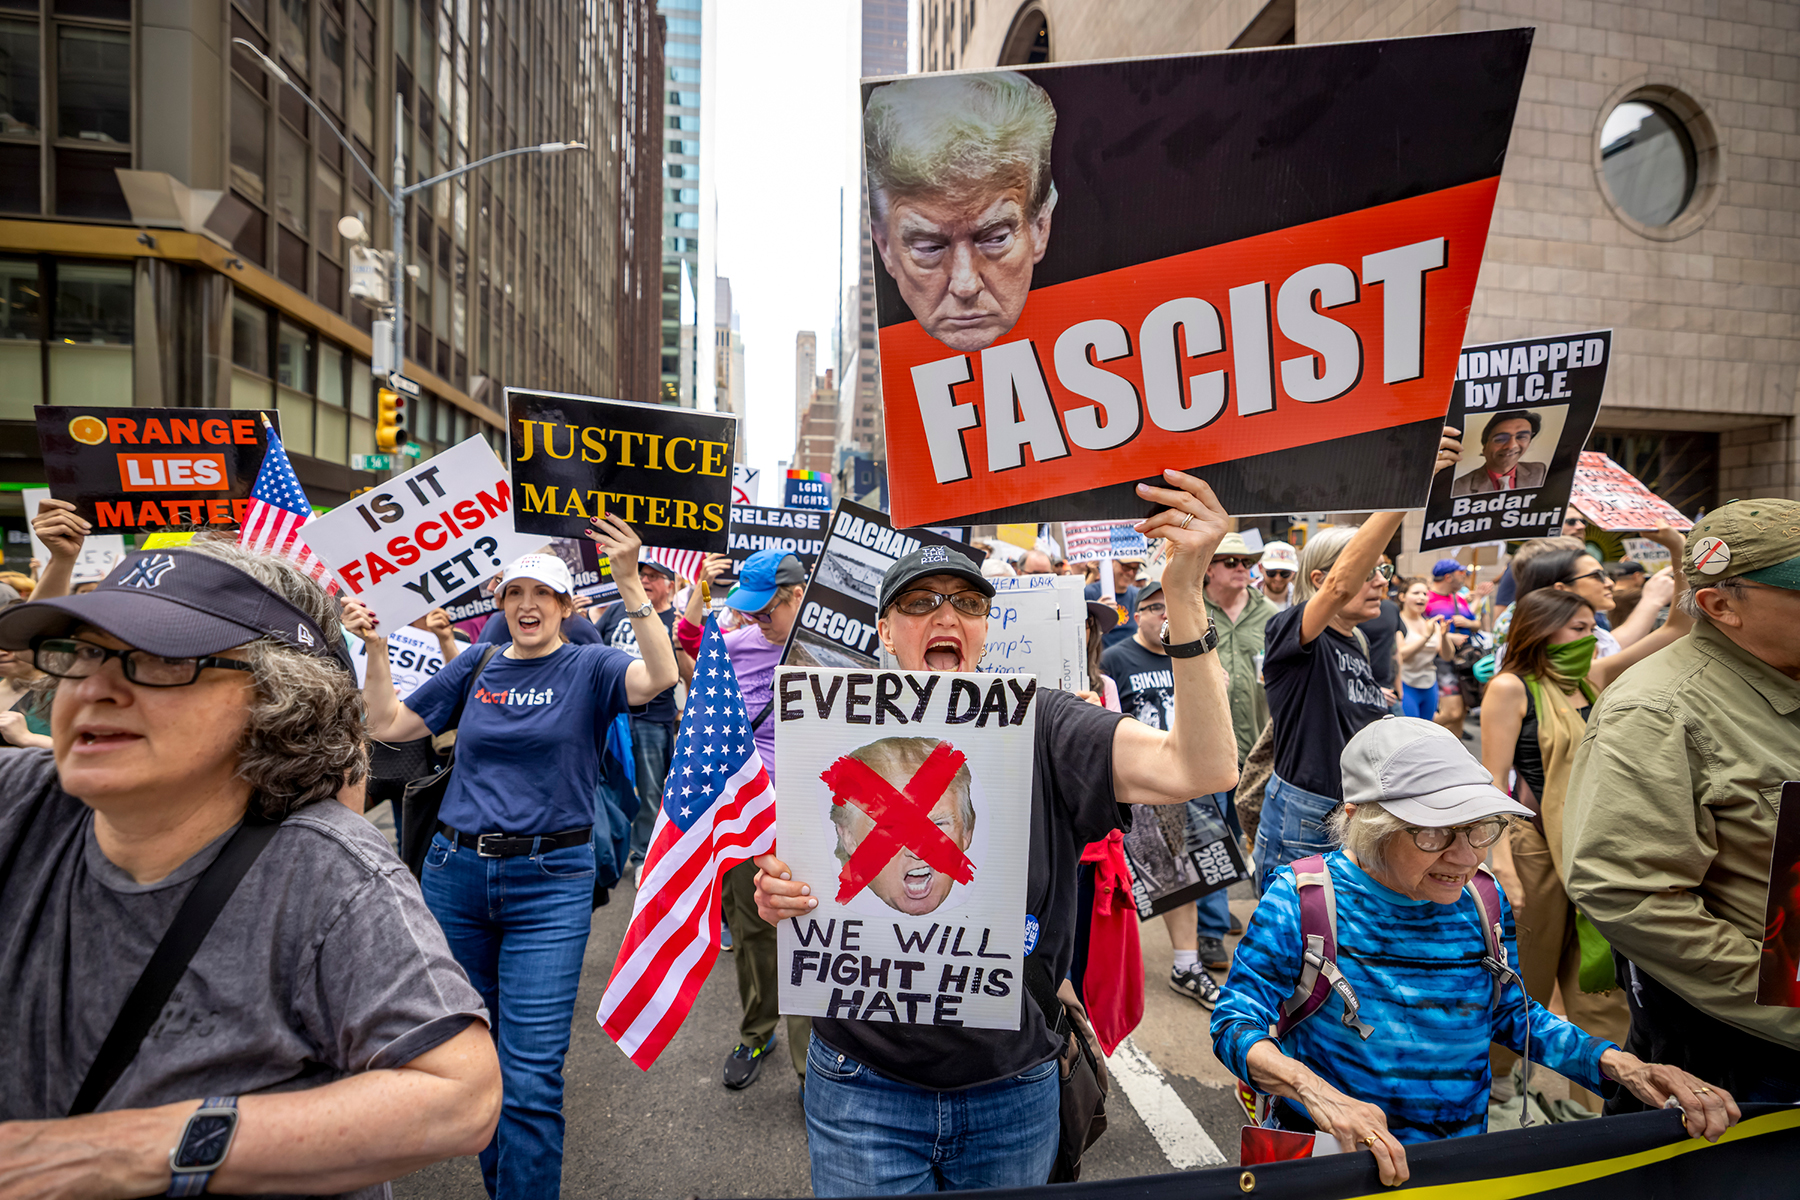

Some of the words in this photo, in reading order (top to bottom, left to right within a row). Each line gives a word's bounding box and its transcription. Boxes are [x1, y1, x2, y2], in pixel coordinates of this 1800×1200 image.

[910, 236, 1450, 484] FASCIST
[1456, 338, 1605, 381] IDNAPPED
[1465, 380, 1502, 409] by
[1507, 371, 1573, 404] I.C.E.
[517, 418, 729, 478] JUSTICE
[126, 458, 222, 486] LIES
[798, 482, 823, 493] LGBT
[356, 493, 404, 533] IS
[405, 465, 447, 507] IT
[520, 482, 725, 533] MATTERS
[791, 494, 829, 506] RIGHTS
[1451, 493, 1537, 518] Badar
[337, 479, 513, 595] FASCISM
[731, 507, 821, 530] RELEASE
[1424, 515, 1492, 541] Khan
[1501, 507, 1562, 529] Suri
[403, 536, 502, 604] YET?
[921, 556, 949, 565] RICH
[1080, 551, 1093, 559] NO
[1096, 550, 1106, 558] TO
[1109, 548, 1147, 556] FASCISM
[1030, 577, 1055, 589] BACK
[801, 601, 877, 652] CECOT
[989, 606, 1017, 630] op
[389, 633, 425, 648] RESIST
[985, 635, 1032, 659] mp's
[1063, 659, 1071, 682] DUTY
[1128, 670, 1173, 692] BIKINI
[779, 671, 941, 725] EVERY
[945, 677, 1037, 728] DAY
[1194, 848, 1222, 886] 2025
[1209, 841, 1239, 880] CECOT
[790, 917, 863, 951] WE
[893, 922, 1012, 960] WILL
[790, 950, 925, 990] FIGHT
[938, 964, 1014, 997] HIS
[826, 988, 964, 1027] HATE
